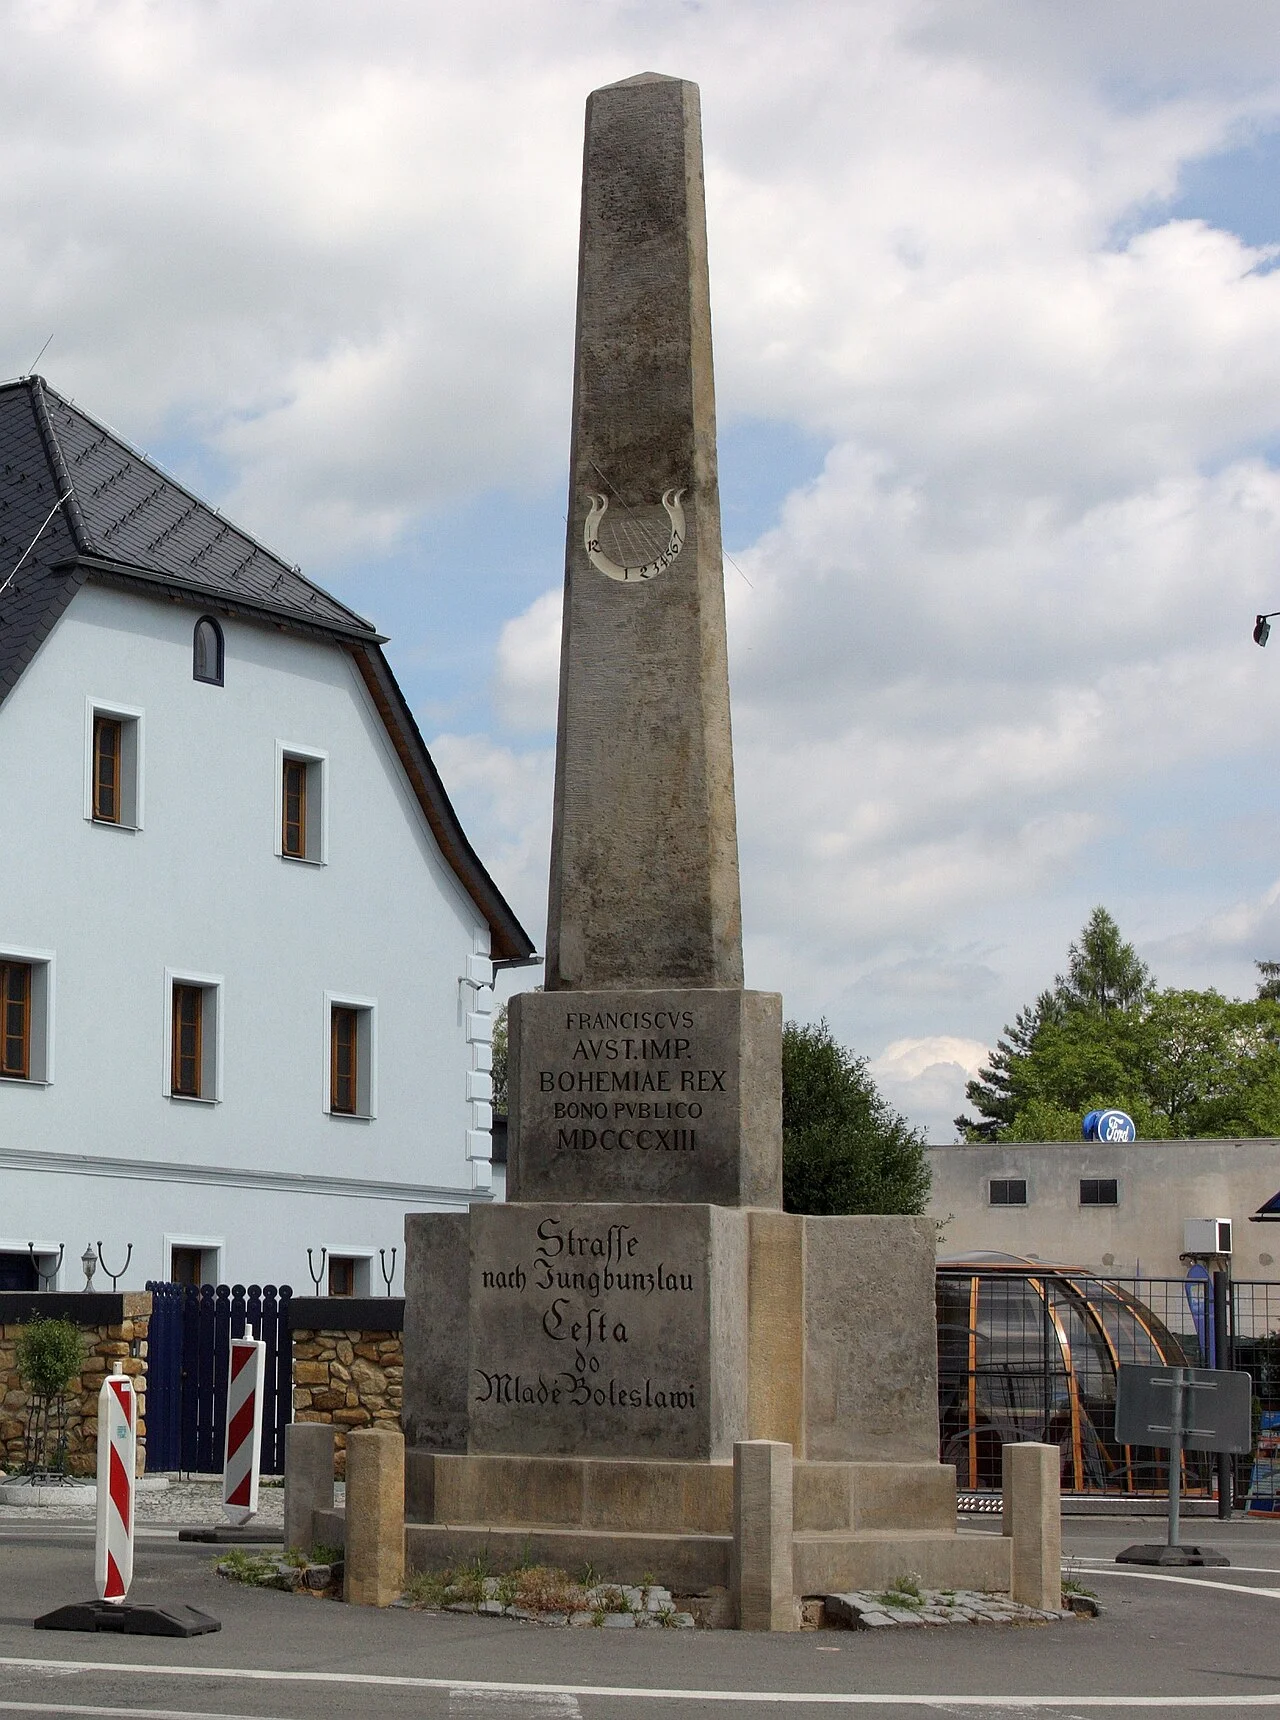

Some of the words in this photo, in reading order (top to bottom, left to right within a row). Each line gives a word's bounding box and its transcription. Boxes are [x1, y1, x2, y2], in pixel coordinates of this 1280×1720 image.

[673, 529, 684, 543] 7
[588, 540, 602, 553] 12
[665, 548, 674, 560] 5
[669, 540, 679, 554] 6
[640, 566, 651, 578] 2
[652, 562, 660, 574] 3
[566, 1012, 694, 1030] FRANCISCVS
[539, 1071, 670, 1092] BOHEMIAE
[681, 1070, 727, 1092] REX
[554, 1102, 608, 1119] BONO
[614, 1102, 703, 1119] PVBLICO
[1106, 1115, 1130, 1142] Ford
[557, 1129, 696, 1151] MDCCCXIII
[481, 1263, 527, 1293] nach
[533, 1257, 694, 1297] Jungbunzlau
[574, 1347, 600, 1373] do
